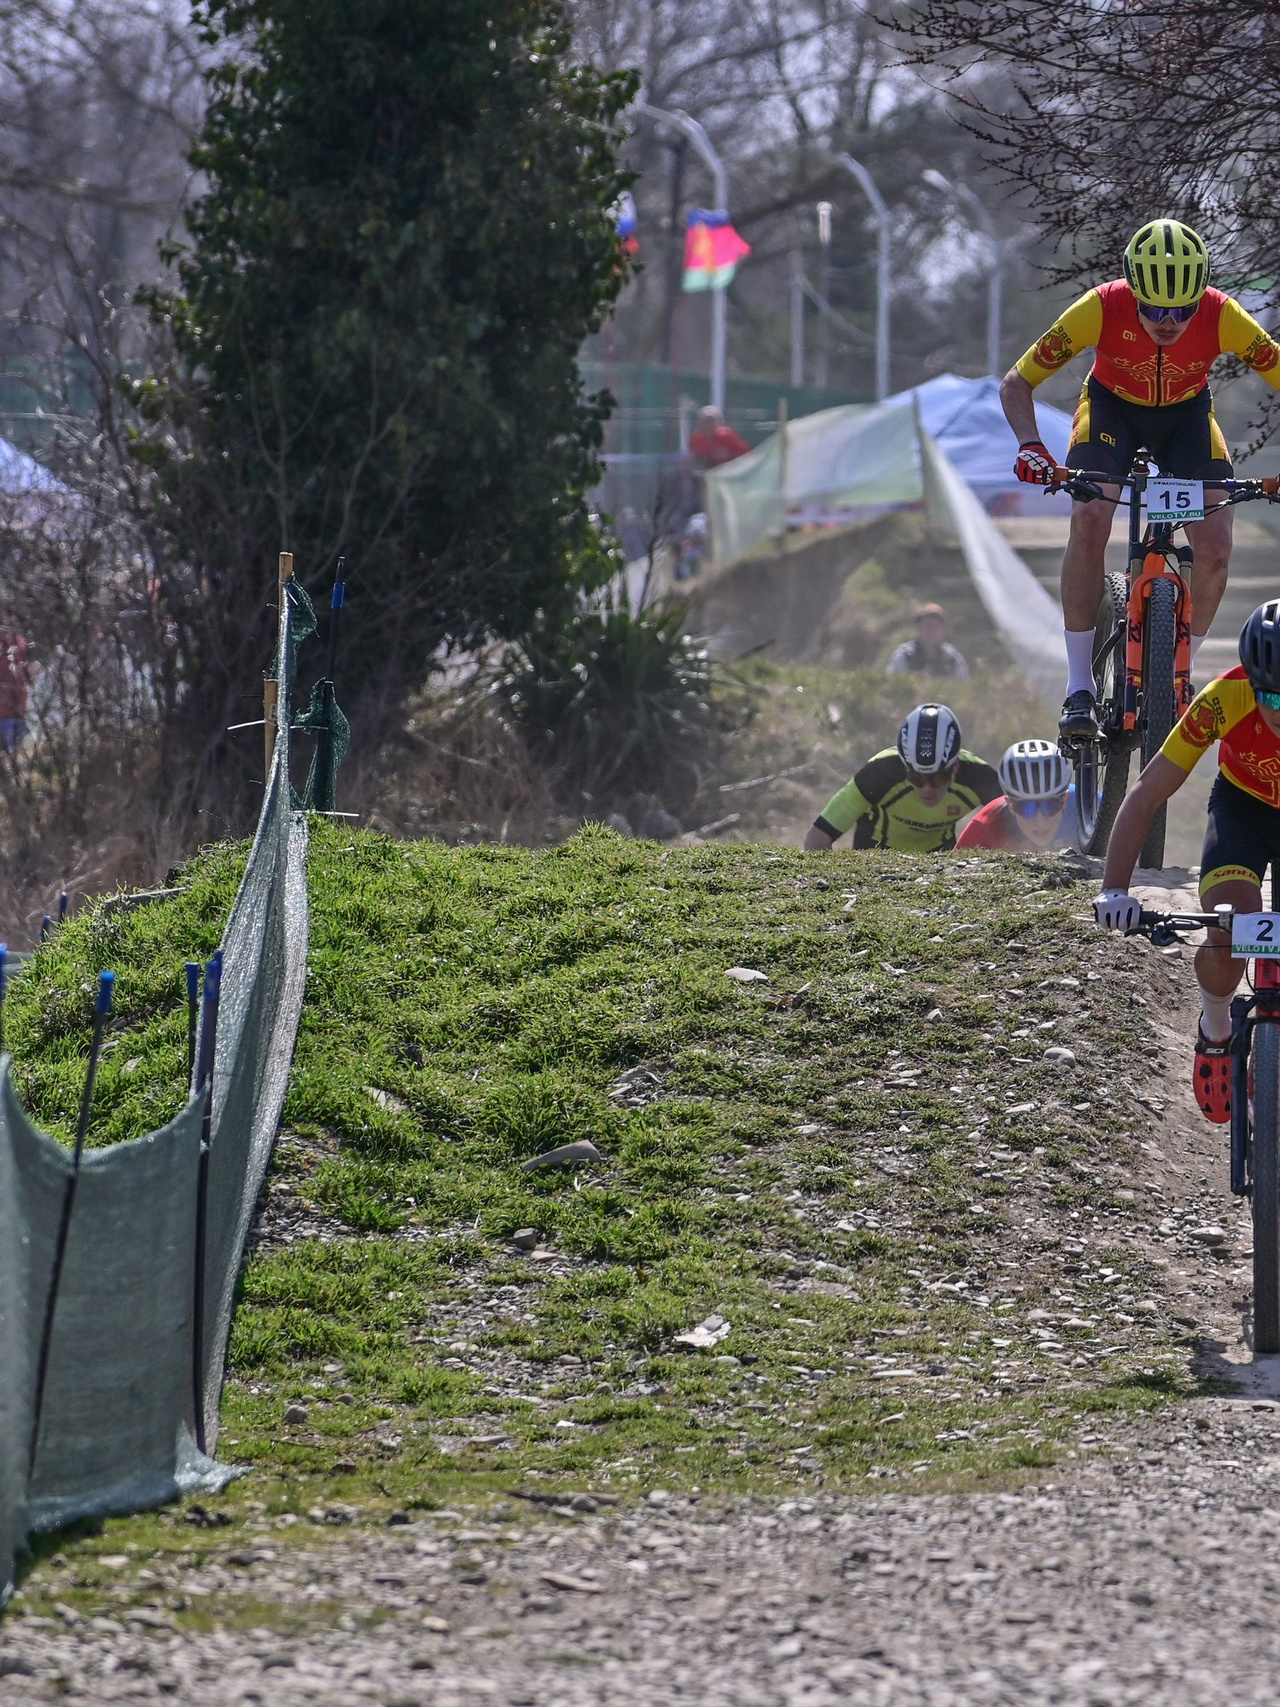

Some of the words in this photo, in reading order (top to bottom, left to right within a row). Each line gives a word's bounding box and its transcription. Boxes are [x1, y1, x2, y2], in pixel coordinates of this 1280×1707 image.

[1159, 490, 1191, 510] 15
[1151, 511, 1201, 520] VELOTV.RU
[1256, 919, 1274, 942] 2
